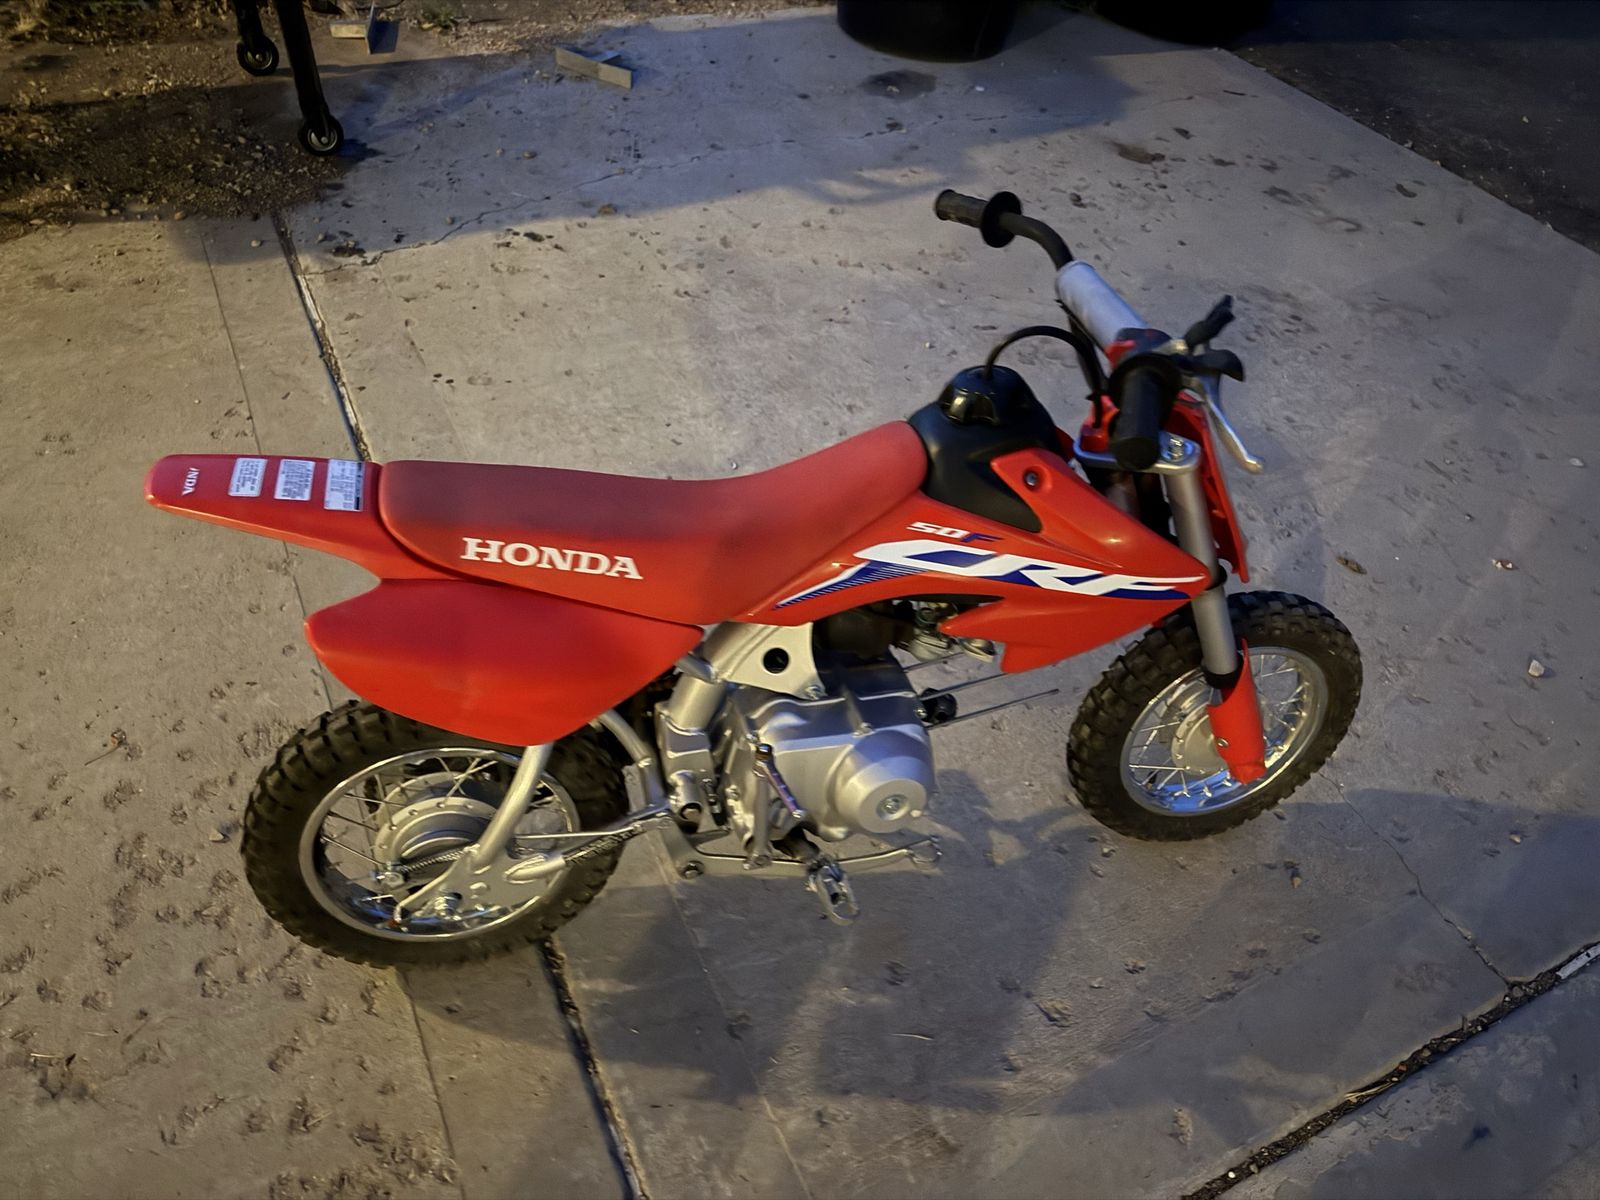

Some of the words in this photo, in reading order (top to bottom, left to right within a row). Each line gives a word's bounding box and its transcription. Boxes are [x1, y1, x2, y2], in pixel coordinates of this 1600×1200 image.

[906, 521, 1005, 543] 50F
[460, 537, 643, 580] HONDA
[853, 539, 1206, 597] CRF
